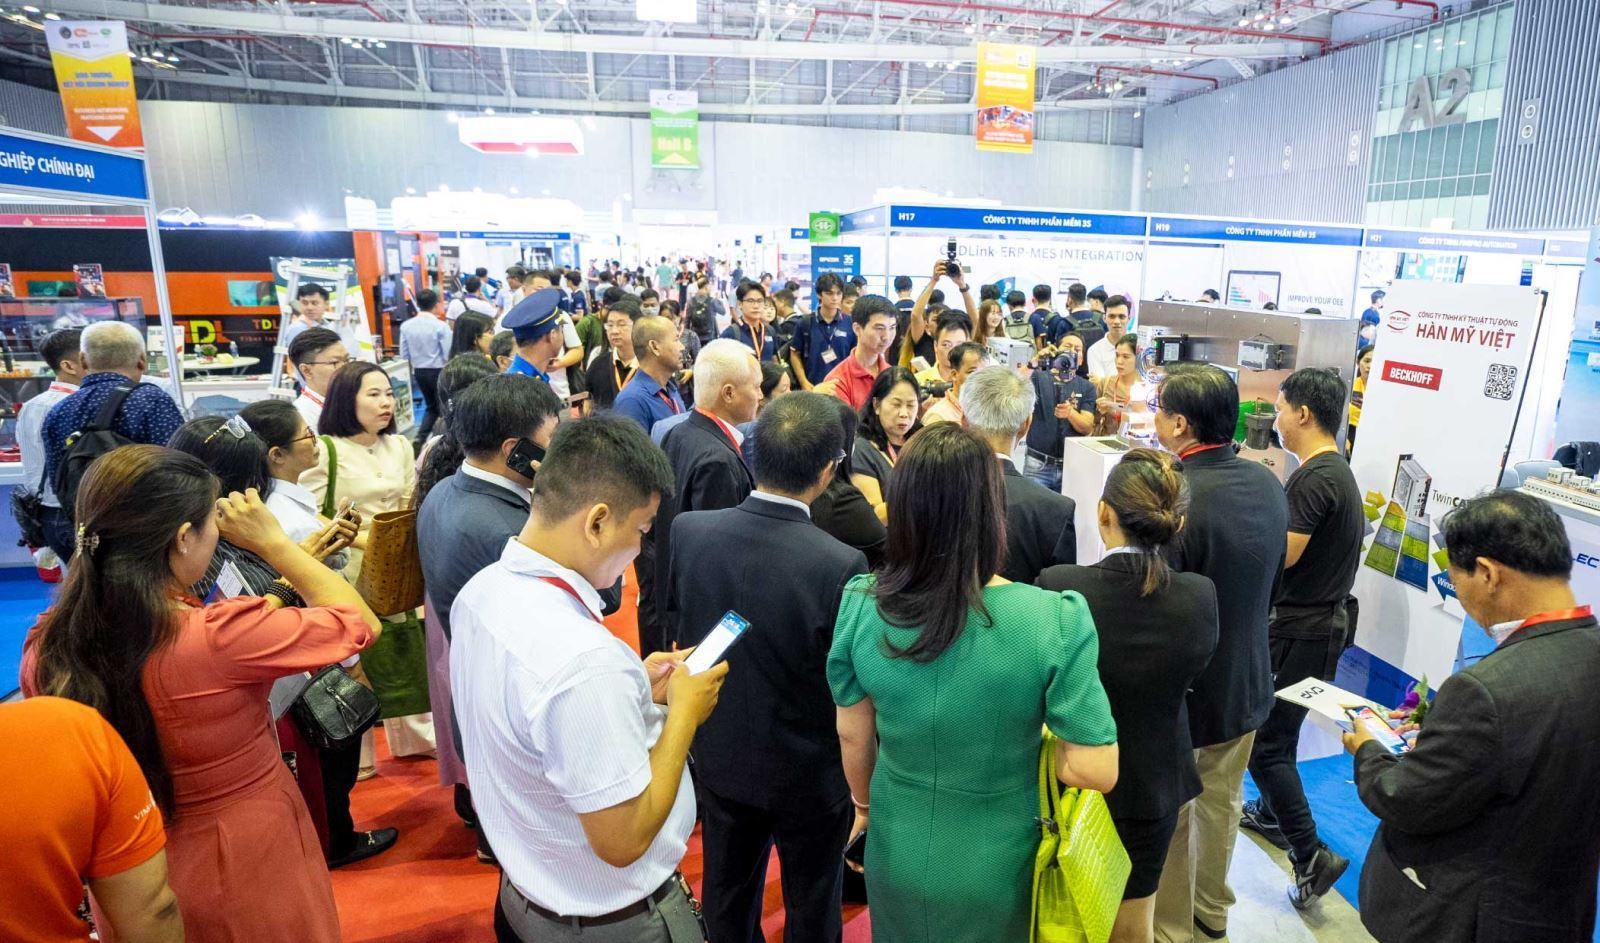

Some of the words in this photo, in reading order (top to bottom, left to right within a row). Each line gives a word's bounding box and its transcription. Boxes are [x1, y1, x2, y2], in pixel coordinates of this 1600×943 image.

[1397, 67, 1471, 133] A2
[37, 157, 75, 177] CHÍNH
[75, 164, 95, 183] ĐẠI
[898, 212, 916, 221] H17
[982, 214, 1006, 224] CÔNG
[1006, 216, 1017, 225] TY
[1018, 216, 1040, 226] TNHH
[1082, 219, 1092, 228] 3S
[1225, 227, 1245, 236] CÔNG
[1254, 229, 1273, 237] TNHH
[940, 245, 994, 257] CDLink
[1000, 246, 1056, 259] ERP-MES
[1060, 248, 1143, 262] INTEGRATION
[1288, 294, 1313, 304] IMPROVE
[1314, 295, 1331, 305] YOUR
[1418, 311, 1434, 319] CÔNG
[1497, 318, 1518, 328] ĐỘNG
[1416, 321, 1448, 341] HÀN
[1450, 325, 1476, 344] MỸ
[1479, 329, 1516, 352] VIỆT
[1390, 367, 1434, 385] BECKHOFF
[1571, 552, 1600, 569] EC
